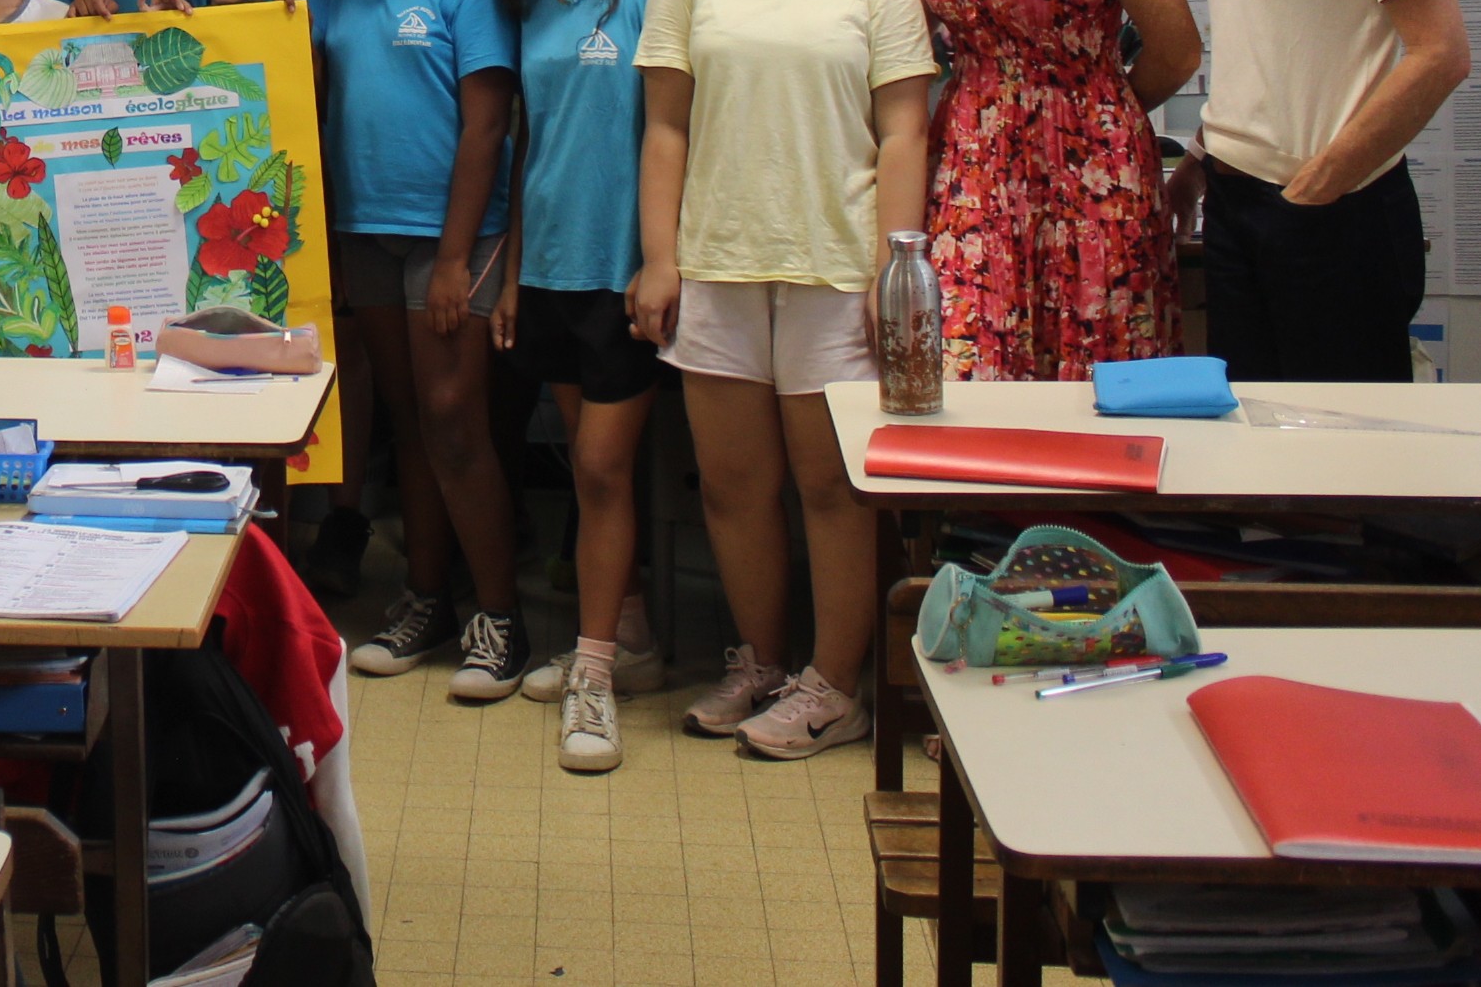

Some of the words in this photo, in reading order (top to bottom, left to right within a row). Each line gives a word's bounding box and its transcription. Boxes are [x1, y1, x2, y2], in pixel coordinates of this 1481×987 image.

[125, 91, 229, 115] écologique
[61, 137, 101, 151] mes
[126, 129, 183, 148] rêves
